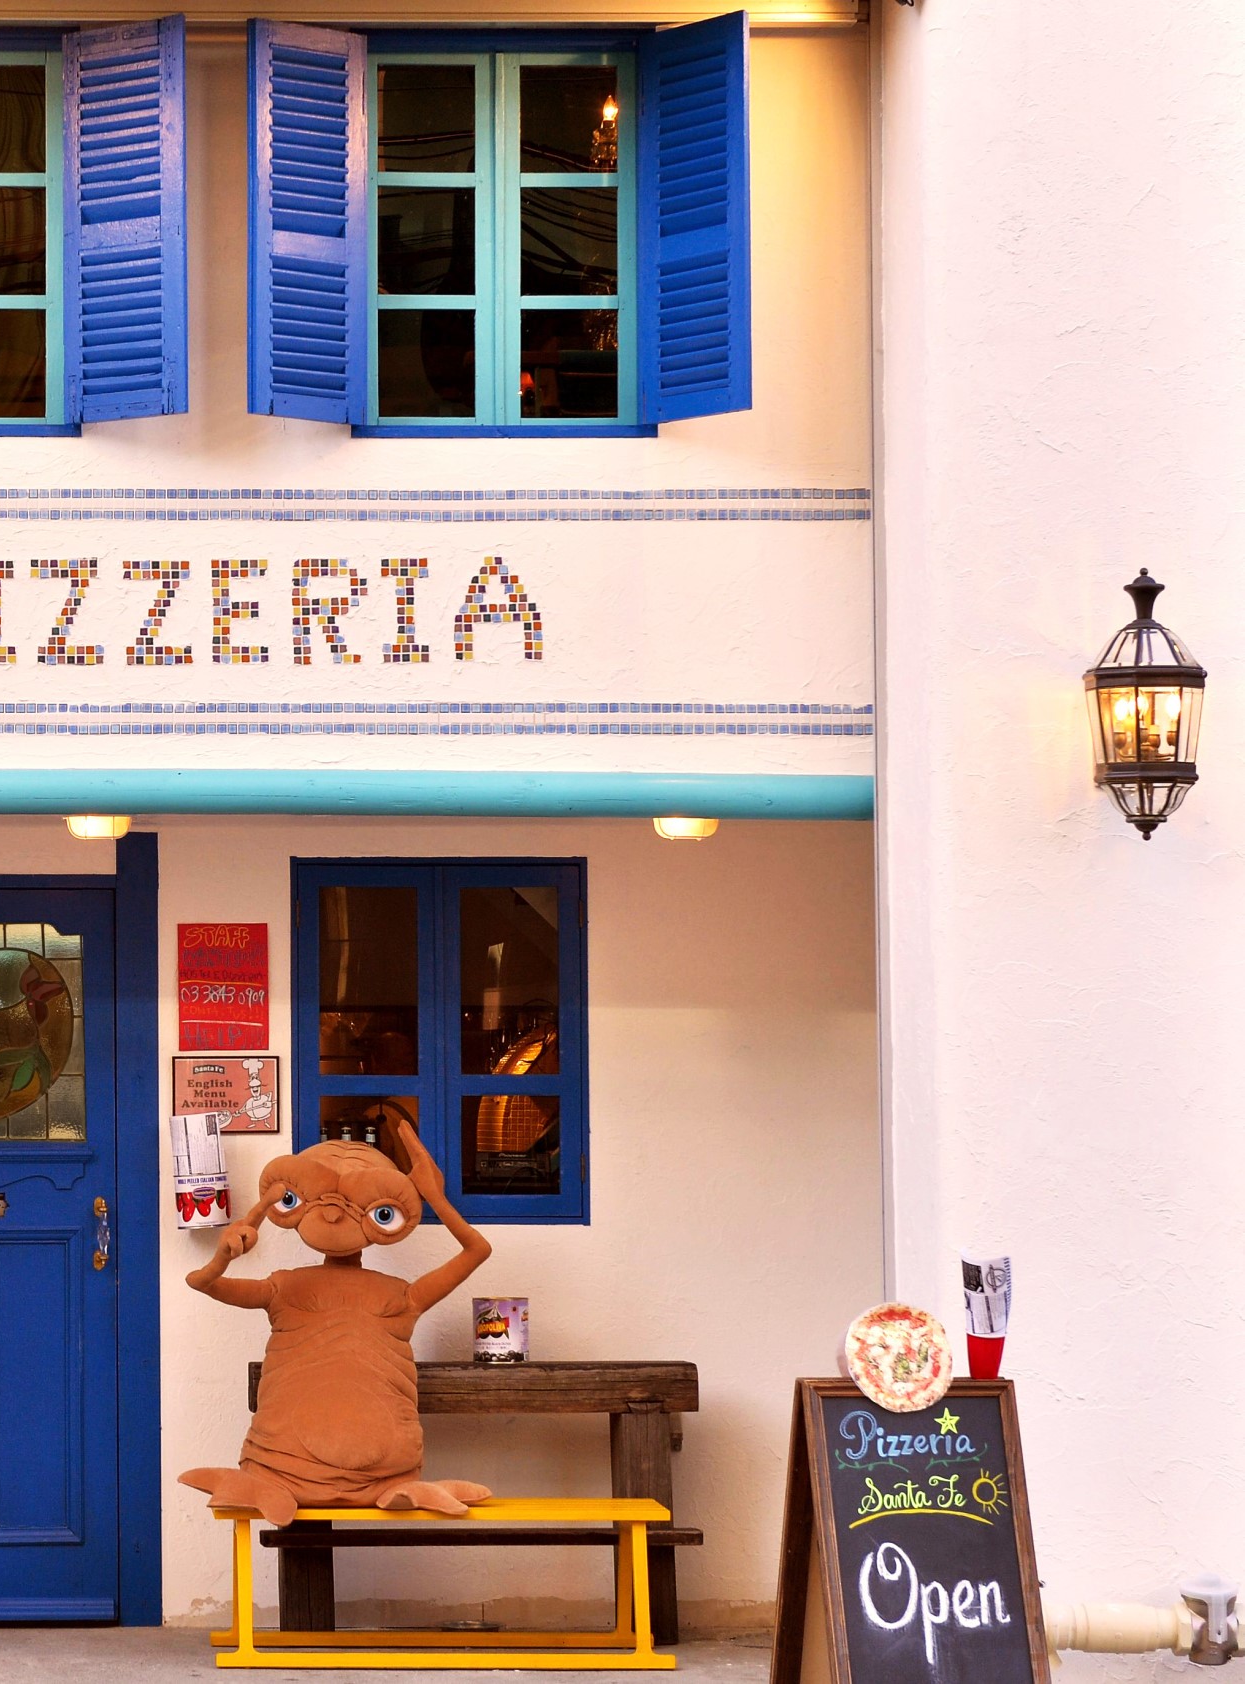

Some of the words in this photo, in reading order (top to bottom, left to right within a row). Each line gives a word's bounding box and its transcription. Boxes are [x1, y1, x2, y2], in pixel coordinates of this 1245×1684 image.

[183, 925, 250, 948] STAFF
[187, 1079, 233, 1089] English
[194, 1090, 226, 1098] Menu
[181, 1100, 239, 1108] Available
[839, 1410, 976, 1459] Pizzeria
[858, 1477, 932, 1514] Santa
[928, 1474, 966, 1507] Fe
[859, 1542, 1011, 1665] Open
